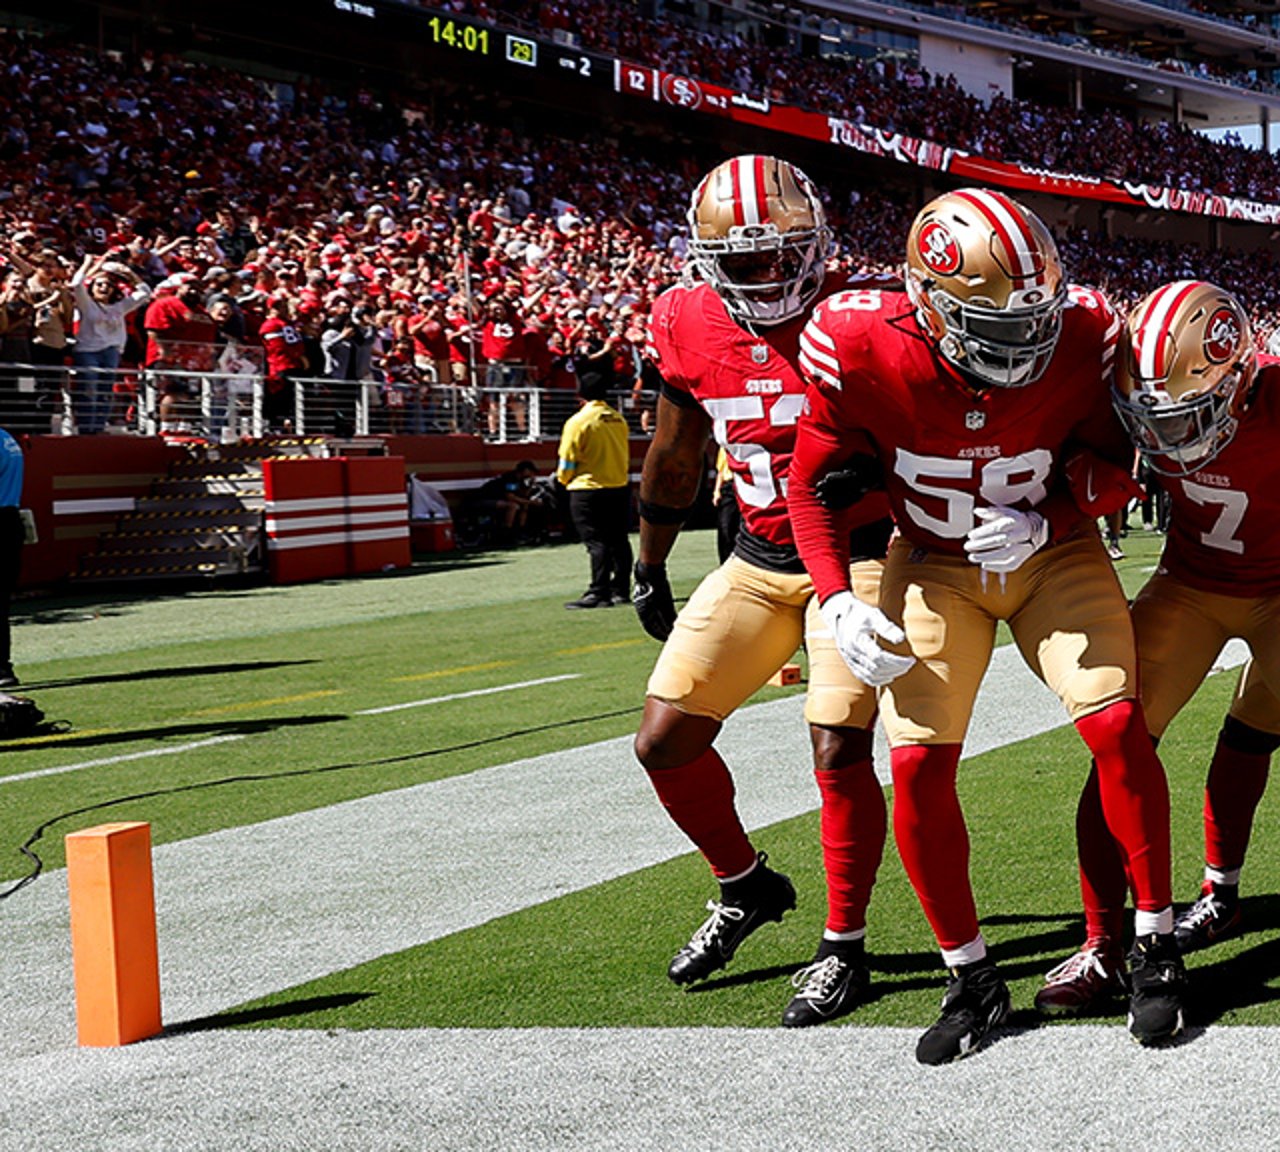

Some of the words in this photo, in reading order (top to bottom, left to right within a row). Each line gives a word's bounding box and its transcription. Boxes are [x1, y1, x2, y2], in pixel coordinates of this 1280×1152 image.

[429, 17, 489, 55] 14:01
[512, 42, 531, 61] 29
[579, 56, 591, 77] 2
[627, 69, 646, 91] 12
[1181, 479, 1250, 555] 7
